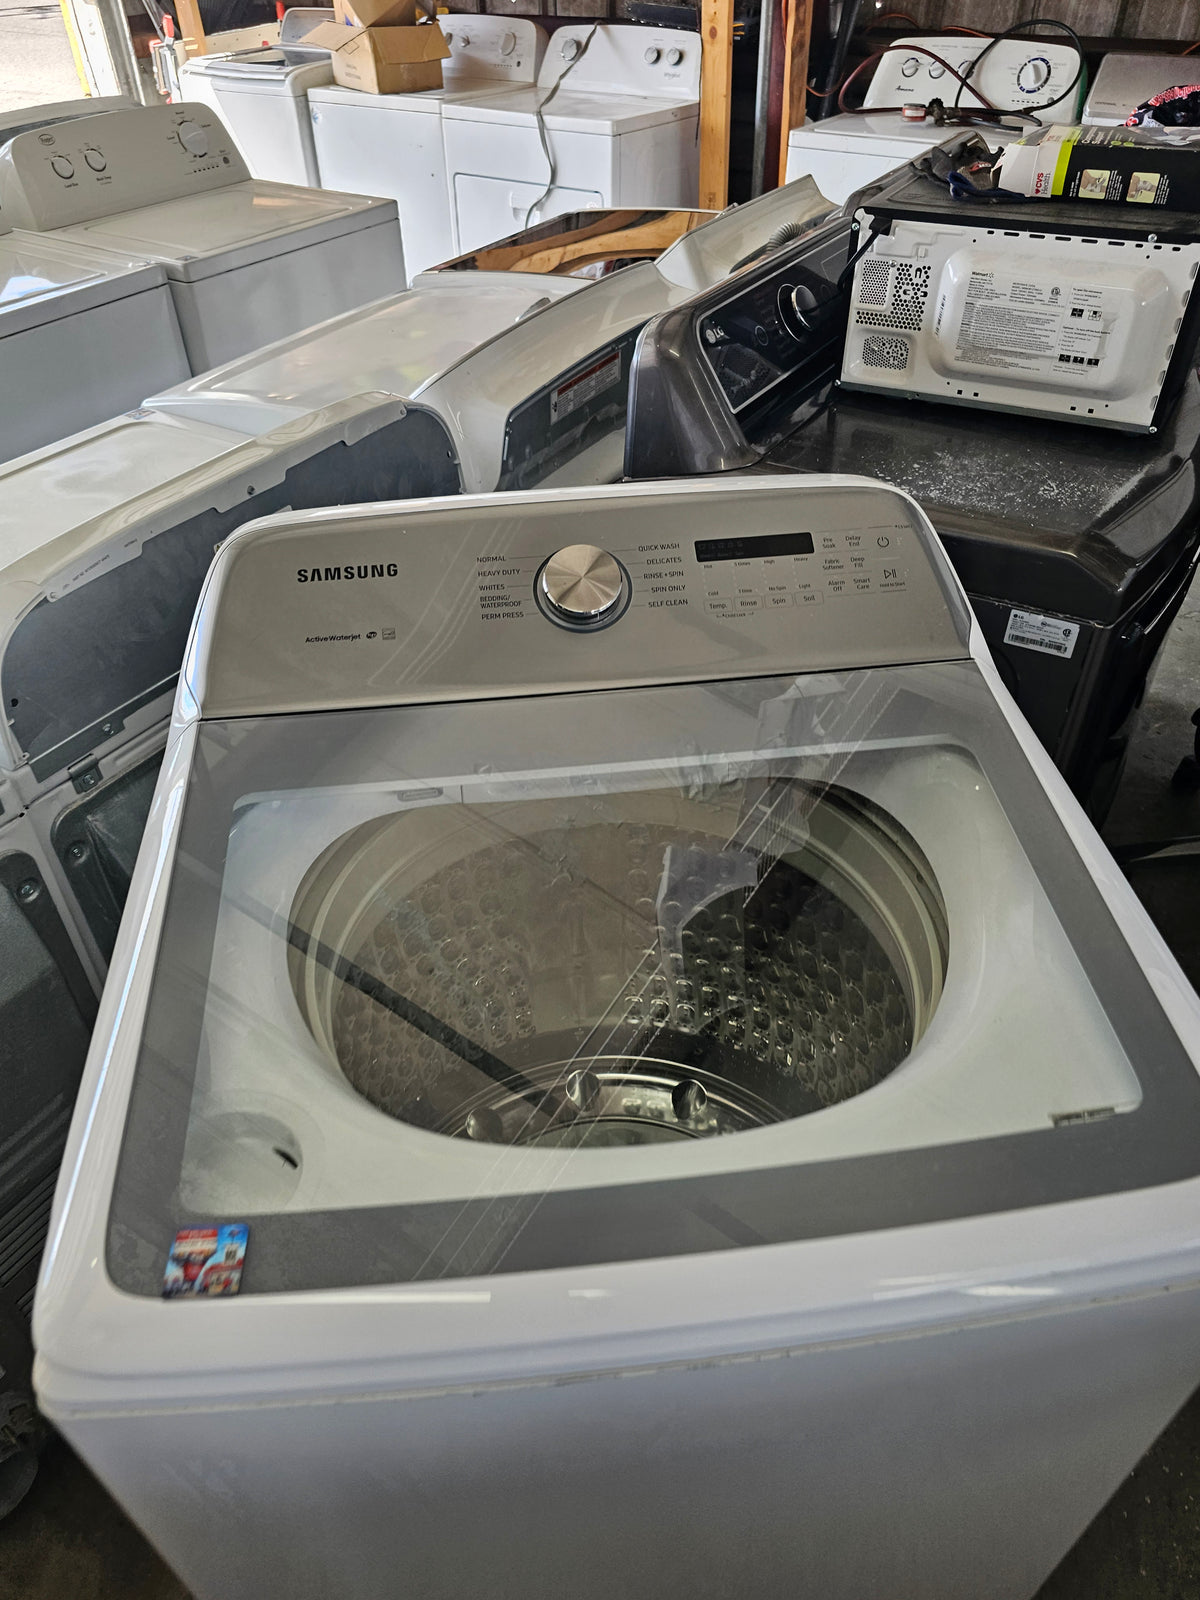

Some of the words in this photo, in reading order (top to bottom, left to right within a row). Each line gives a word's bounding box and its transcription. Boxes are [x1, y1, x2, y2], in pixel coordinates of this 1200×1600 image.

[1036, 172, 1044, 188] CVS
[1041, 172, 1051, 195] Health
[712, 325, 725, 339] LG
[297, 564, 398, 583] SAMSUNG
[305, 633, 361, 643] ActiveWaterjet
